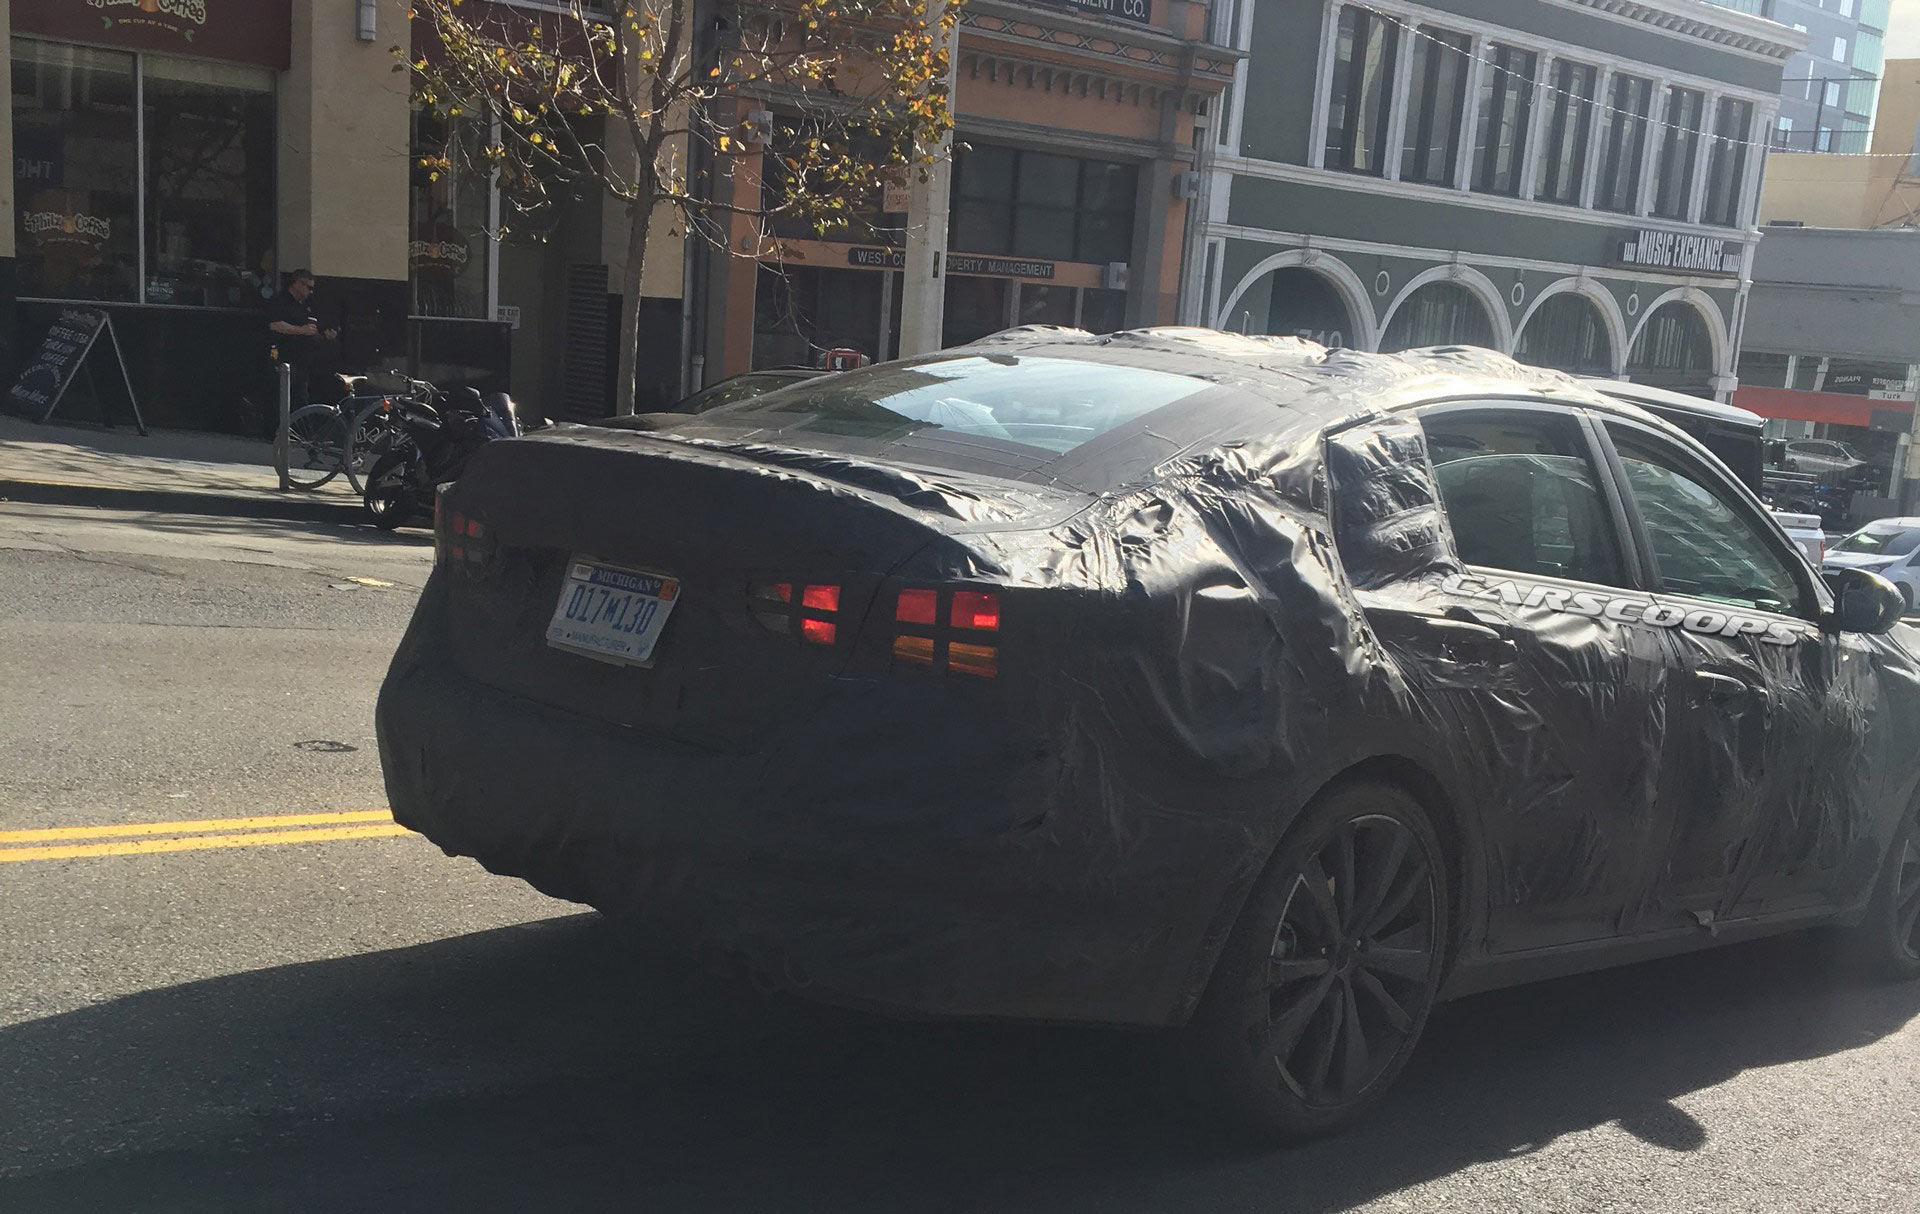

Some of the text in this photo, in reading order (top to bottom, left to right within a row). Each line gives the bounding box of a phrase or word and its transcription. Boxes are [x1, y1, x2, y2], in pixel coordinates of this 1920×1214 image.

[1123, 0, 1146, 18] CO.
[1636, 230, 1725, 272] MUSIC EXCHANGE
[857, 251, 887, 266] WEST
[988, 260, 1053, 277] MANAGEMENT
[1882, 391, 1901, 400] Turk
[598, 569, 651, 591] MICHIGAN
